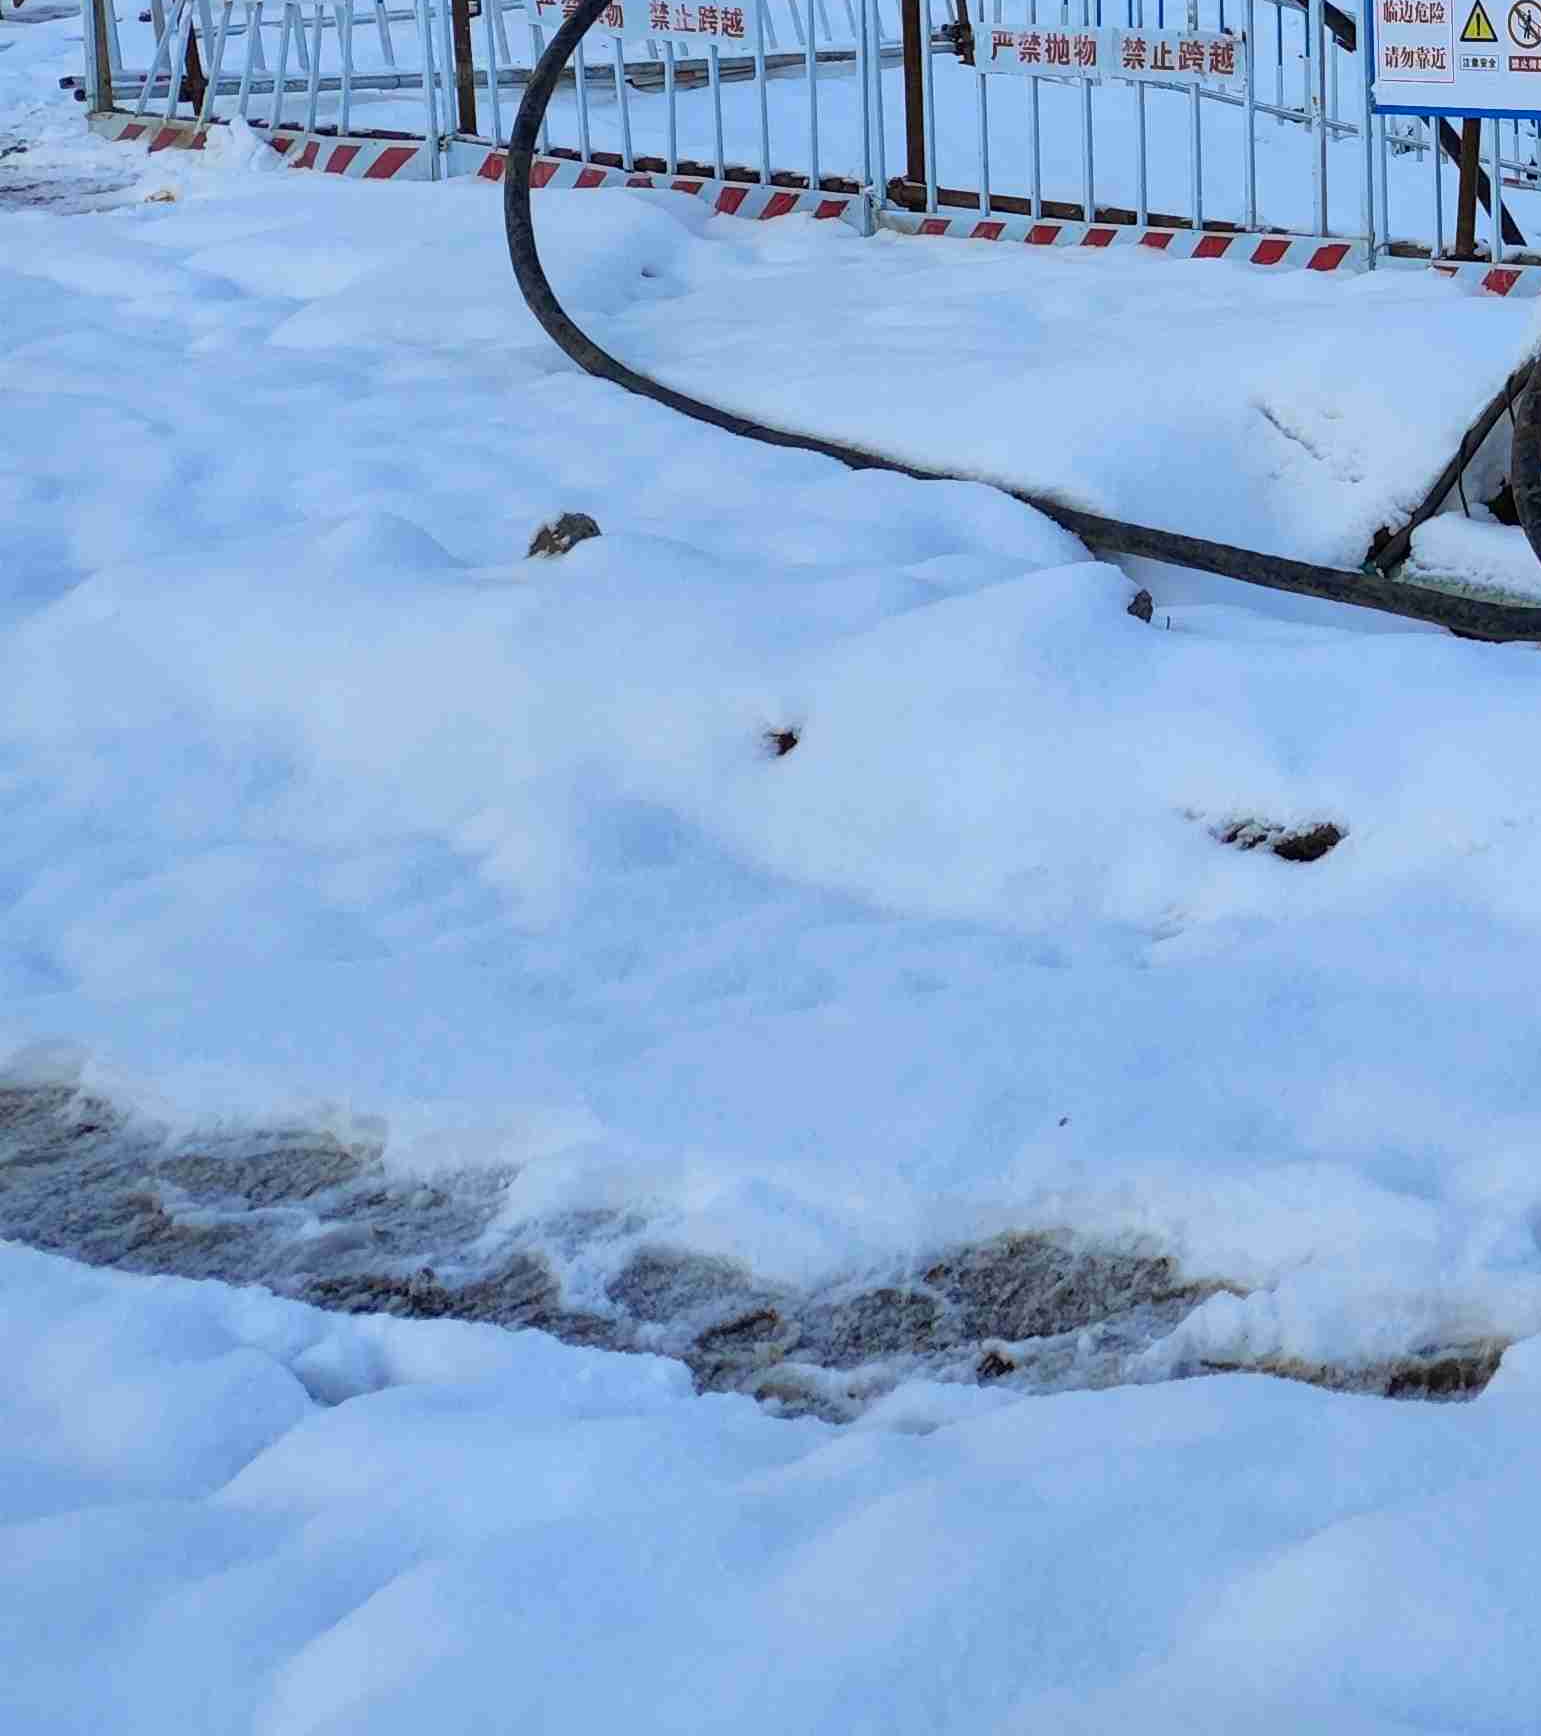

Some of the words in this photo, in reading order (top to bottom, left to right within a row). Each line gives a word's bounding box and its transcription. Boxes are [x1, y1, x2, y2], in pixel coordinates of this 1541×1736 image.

[650, 0, 744, 38] 禁止跨越
[1383, 0, 1445, 24] 临边危险
[991, 30, 1097, 67] 严禁抛物
[1122, 36, 1235, 75] 禁止跨越
[1385, 46, 1447, 70] 请勿靠近
